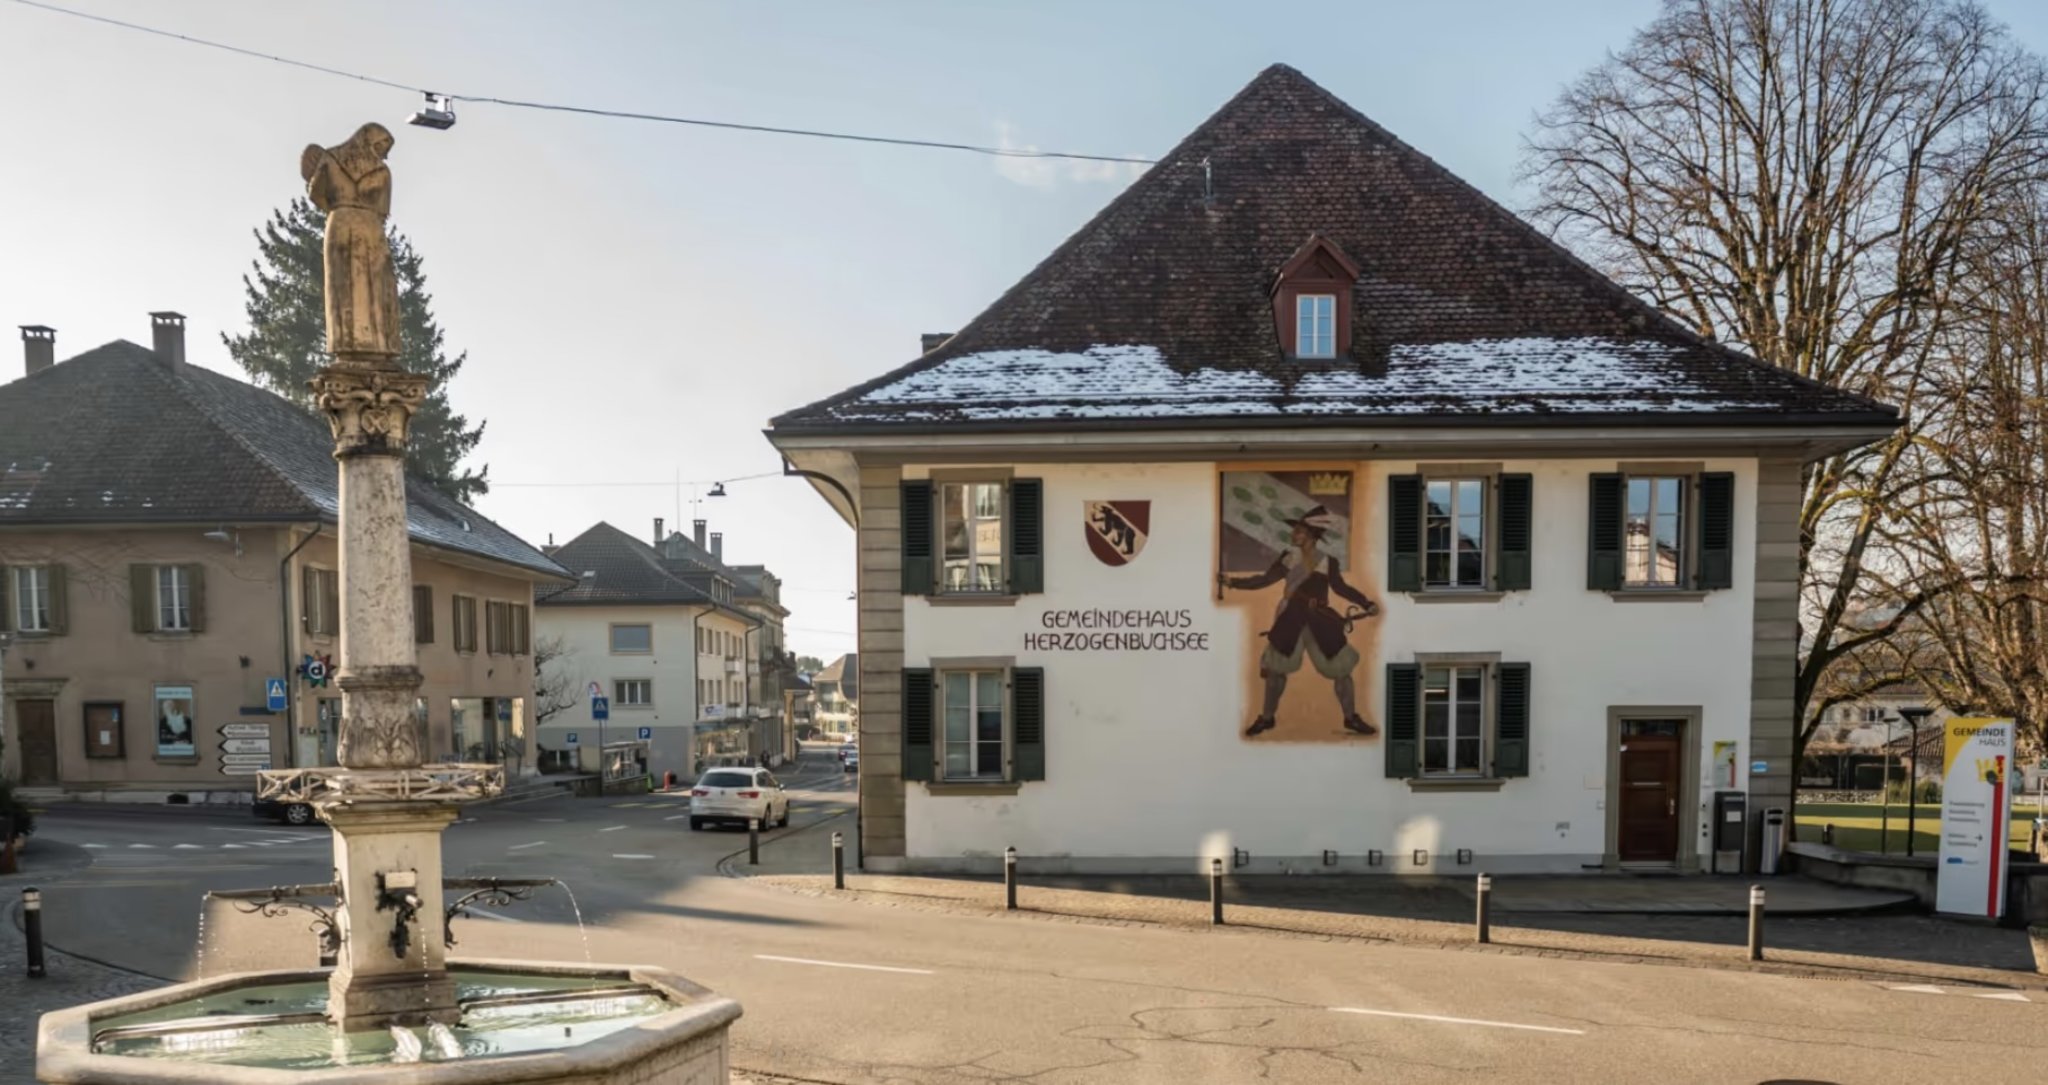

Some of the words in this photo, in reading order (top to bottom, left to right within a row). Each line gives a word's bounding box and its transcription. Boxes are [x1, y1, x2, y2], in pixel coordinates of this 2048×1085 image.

[1042, 608, 1192, 628] GEMEINDEHAUS
[1024, 632, 1209, 651] HERZOGENBUCHSEE
[1953, 727, 2006, 736] GEMEINDE
[1979, 737, 2006, 746] HAUS
